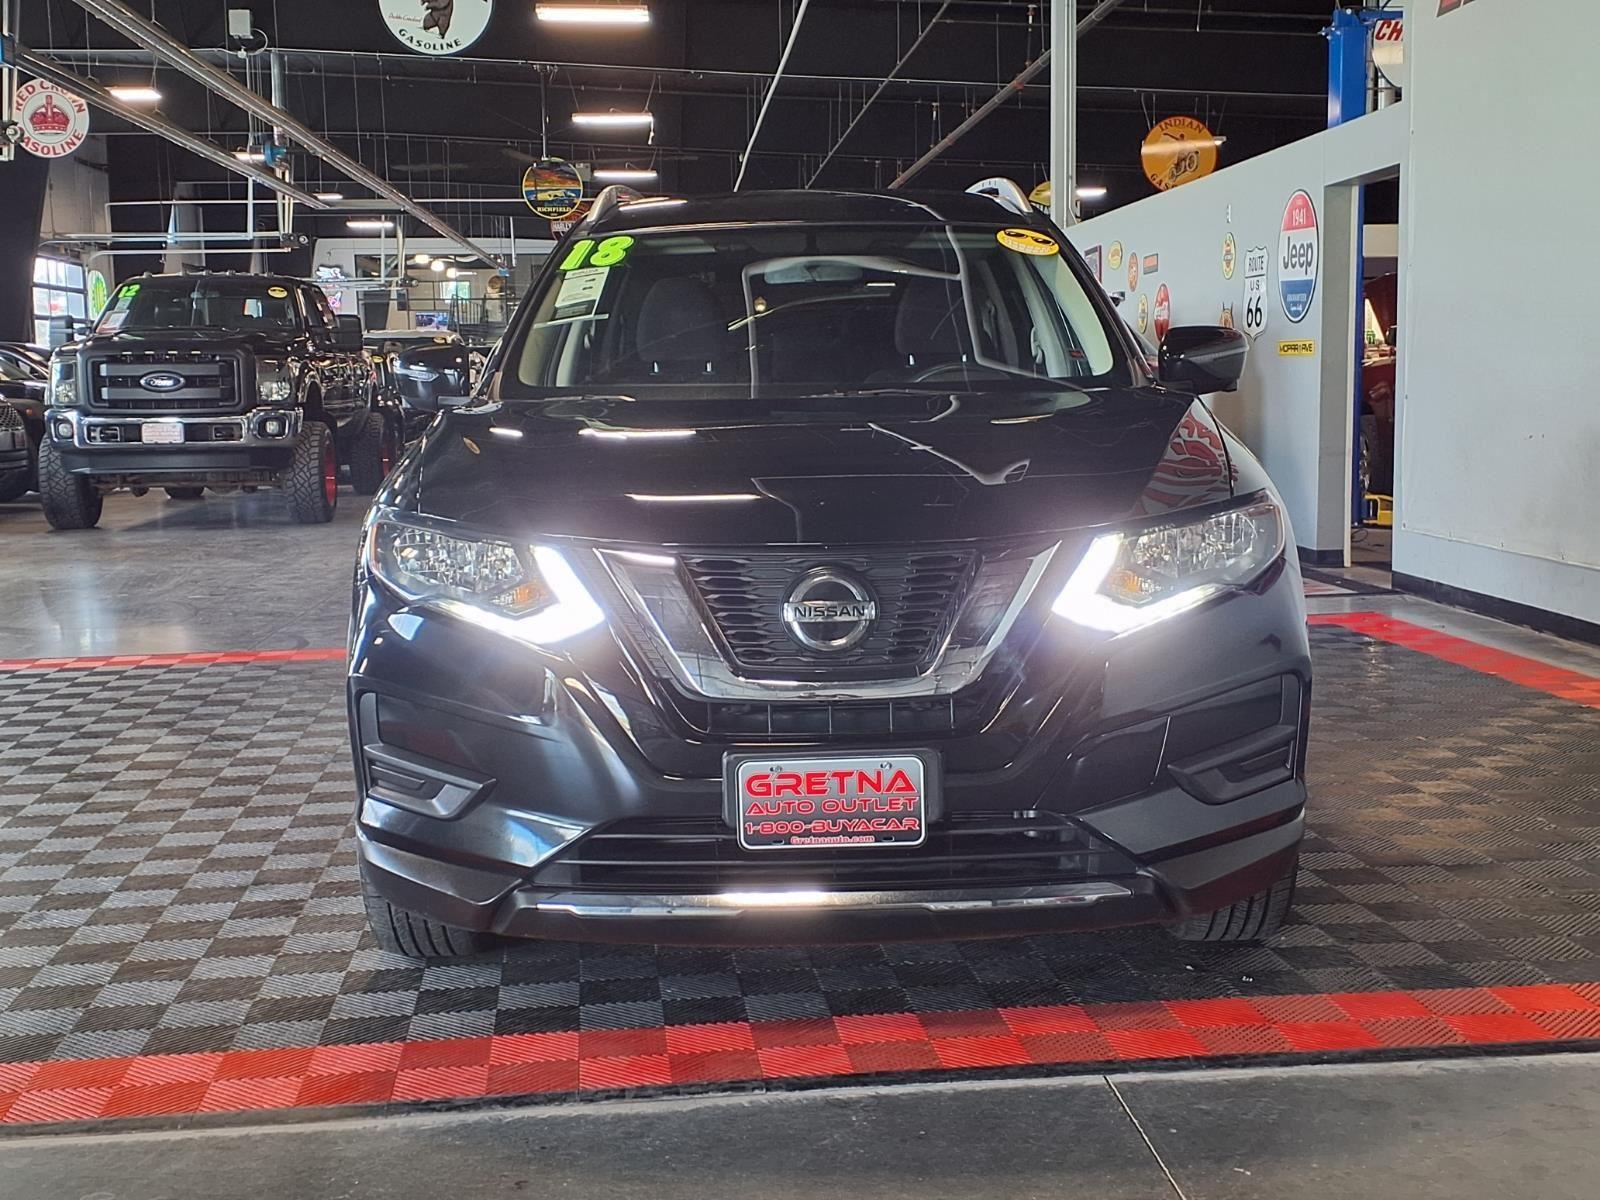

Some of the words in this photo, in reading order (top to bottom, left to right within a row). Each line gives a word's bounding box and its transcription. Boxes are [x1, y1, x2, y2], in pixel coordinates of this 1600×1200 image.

[398, 29, 462, 50] GASOLINE
[1375, 20, 1403, 41] CH
[16, 84, 36, 112] RED
[40, 80, 86, 113] CRN
[1159, 118, 1204, 134] INDIAN
[18, 127, 84, 156] ASOLINE
[1292, 207, 1306, 226] 1941
[560, 236, 634, 270] 18
[1283, 236, 1314, 276] Jeep
[1248, 255, 1264, 272] ROUTE
[118, 284, 140, 298] 12
[1250, 279, 1260, 291] US
[1246, 295, 1262, 328] 66
[149, 376, 174, 388] Ford
[794, 605, 865, 617] NISSAN
[745, 769, 918, 798] GRETNA
[745, 800, 815, 816] AUTO
[821, 796, 919, 813] OUTLET
[745, 817, 920, 835] 1-800-BUYACAR
